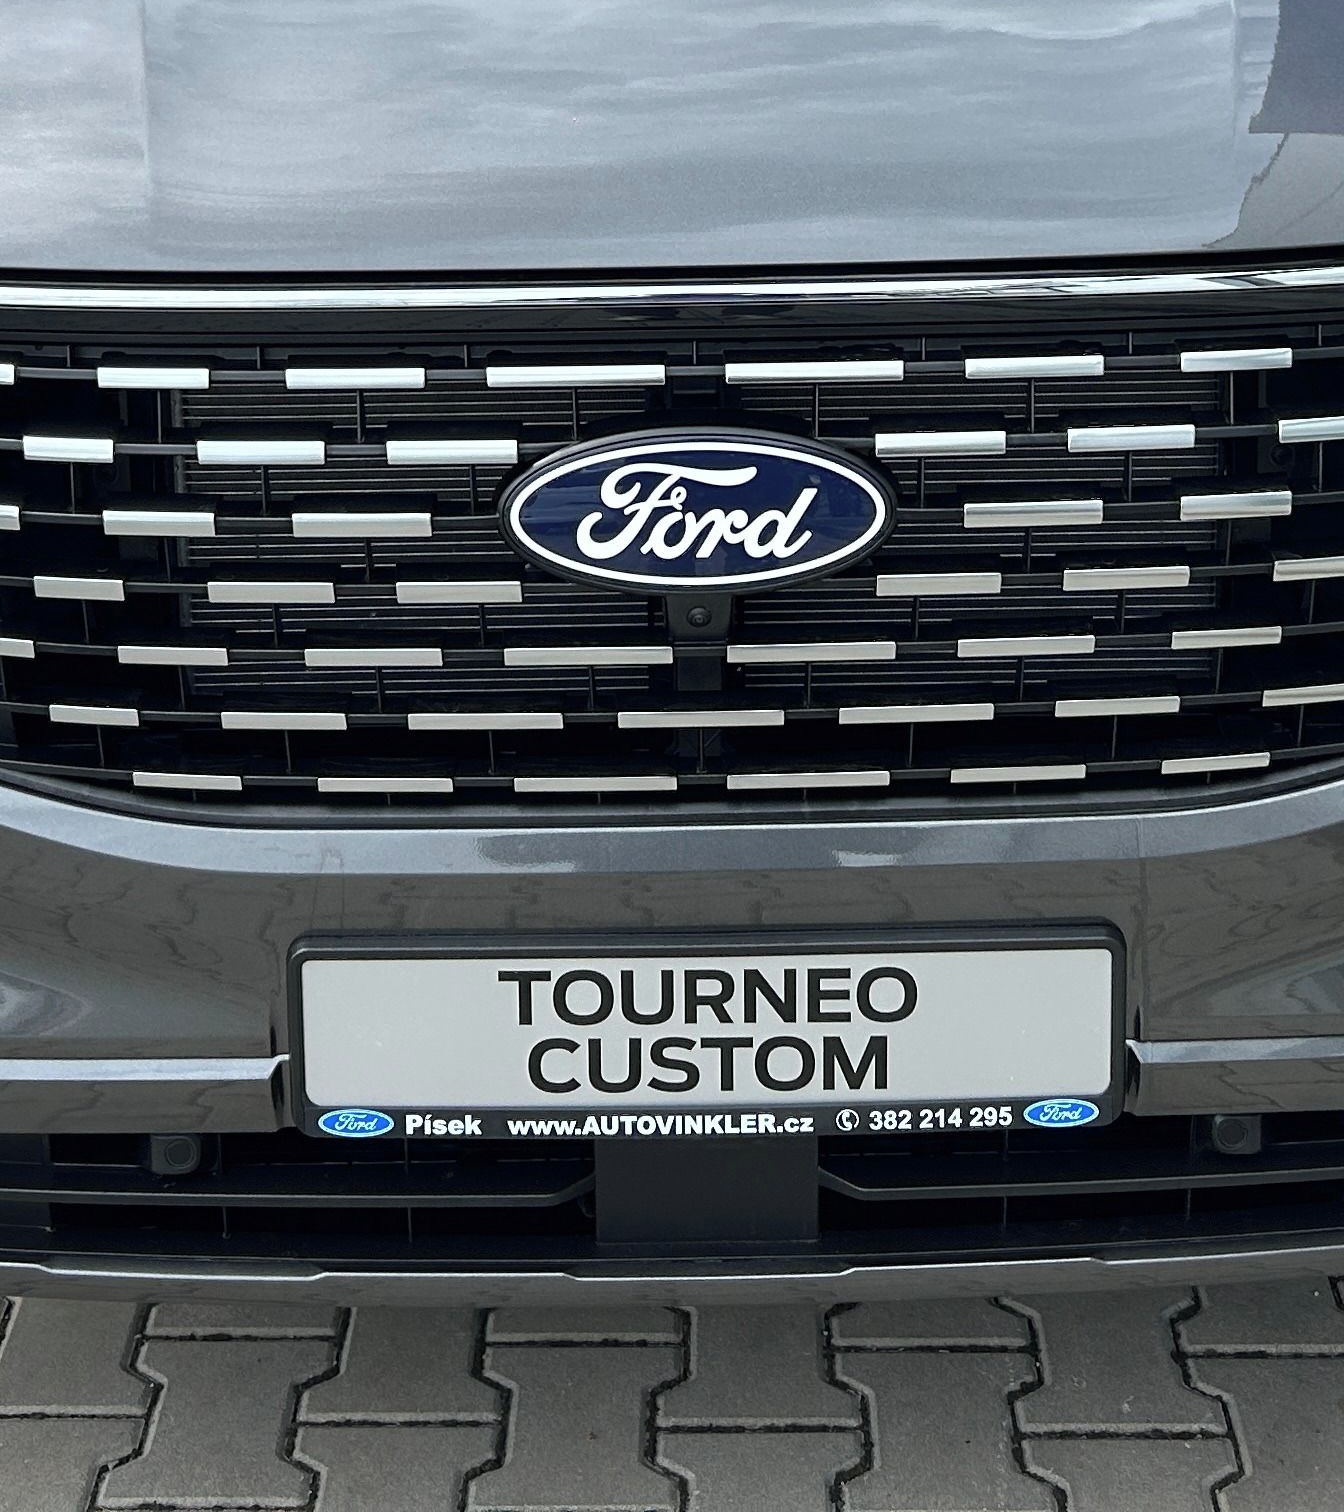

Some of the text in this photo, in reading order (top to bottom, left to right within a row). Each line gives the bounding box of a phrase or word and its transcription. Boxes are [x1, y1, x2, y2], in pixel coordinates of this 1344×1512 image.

[576, 462, 818, 560] Ford
[497, 966, 918, 1026] TOURNEO
[527, 1035, 888, 1094] CUSTOM
[404, 1113, 483, 1136] Písek
[507, 1113, 814, 1137] www.AUTOVINKLER.cz
[868, 1109, 912, 1131] 382
[918, 1108, 963, 1130] 214
[969, 1106, 1014, 1128] 295
